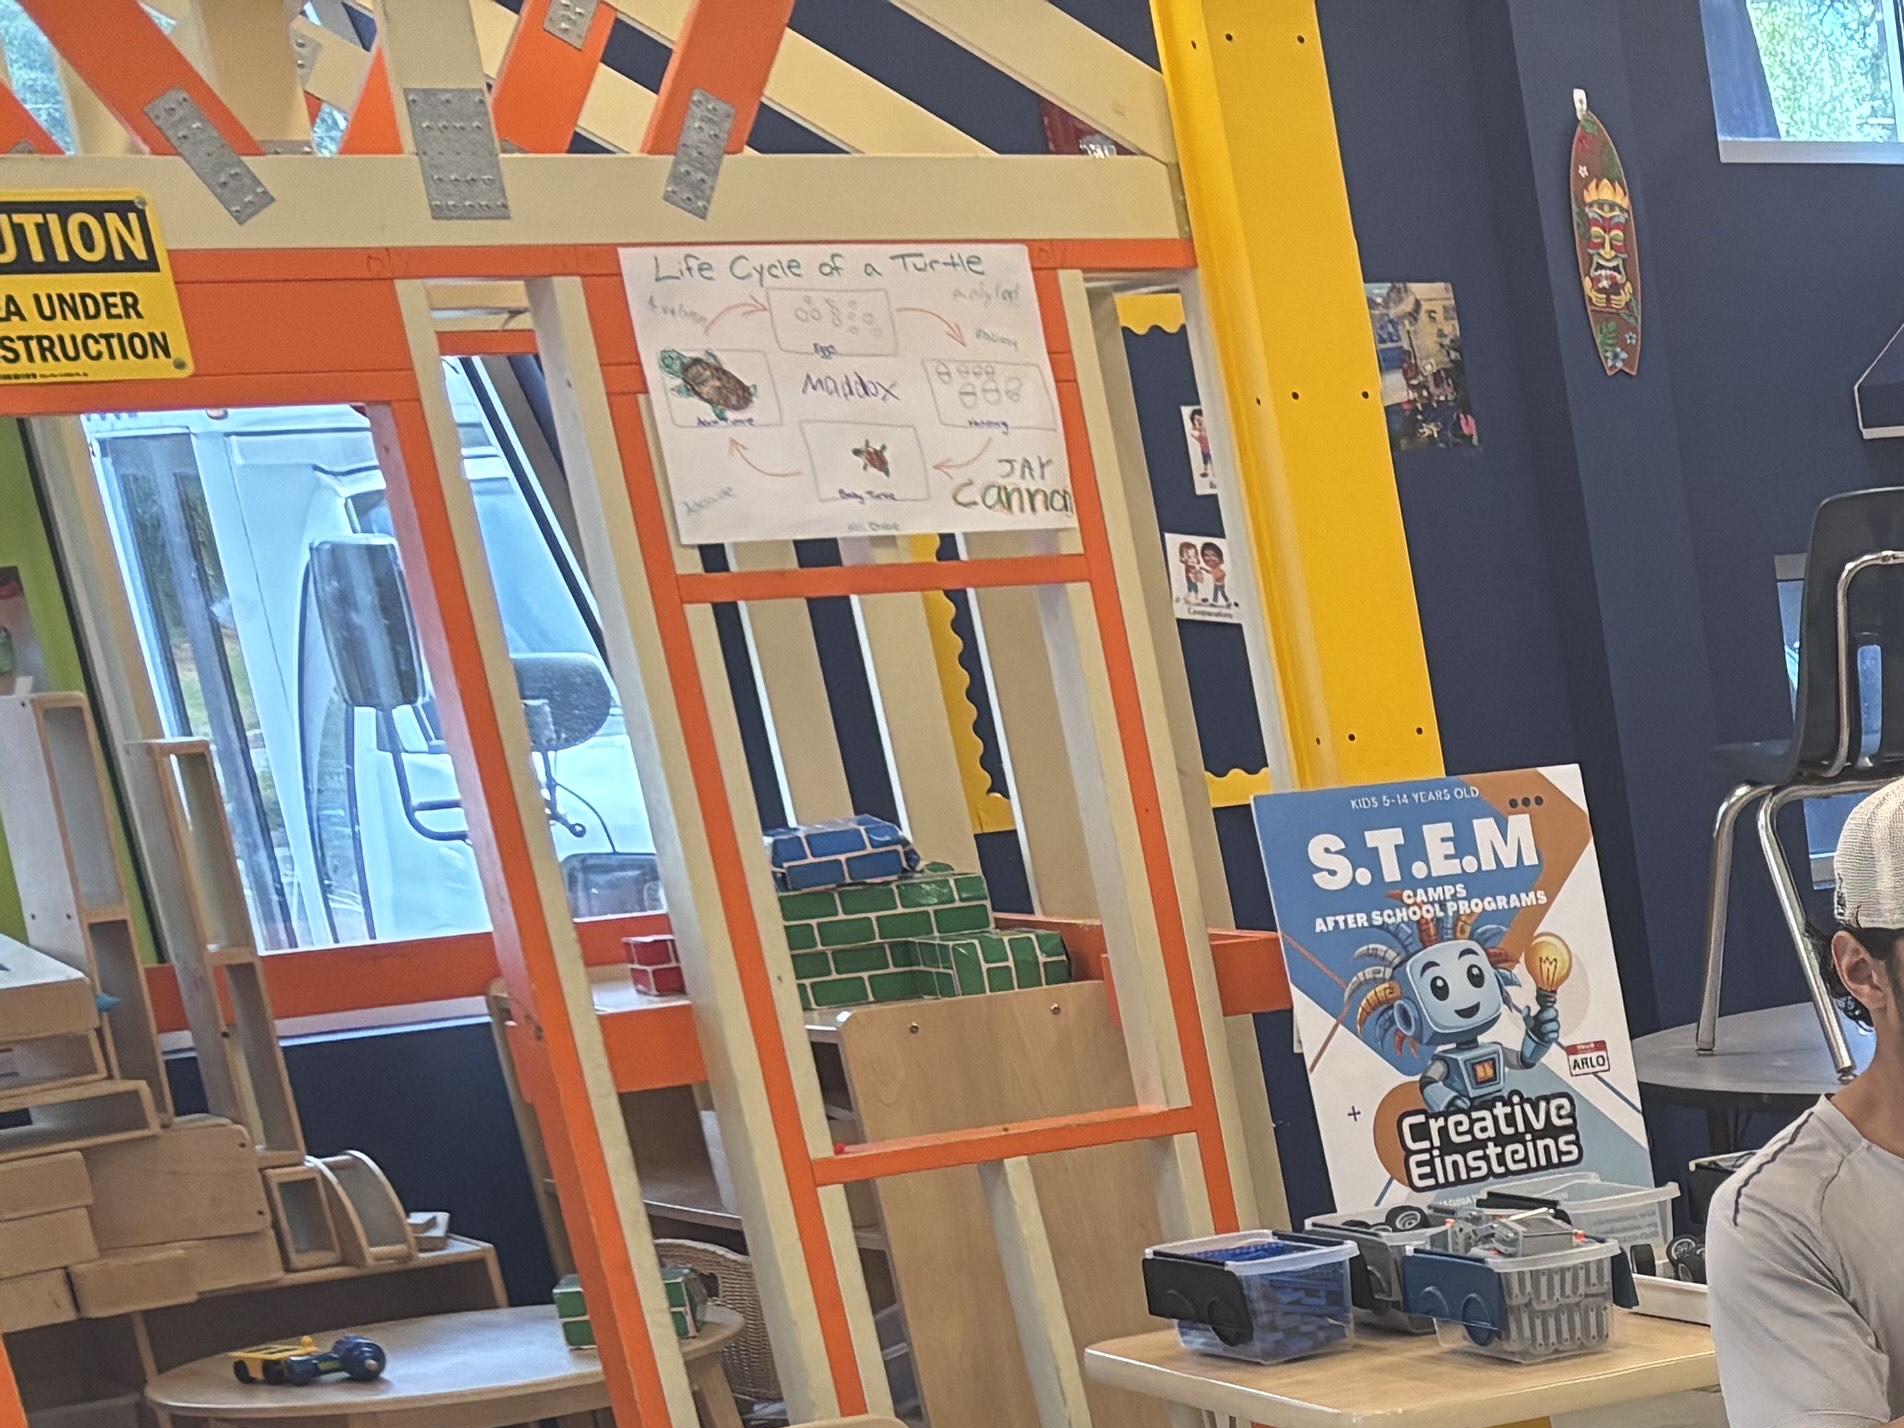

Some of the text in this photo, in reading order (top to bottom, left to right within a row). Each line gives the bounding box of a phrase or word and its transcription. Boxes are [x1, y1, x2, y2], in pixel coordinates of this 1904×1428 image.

[653, 251, 985, 290] Life Cycle of a Turtle
[32, 290, 144, 322] UNDER
[1350, 796, 1378, 811] KIDS
[1411, 789, 1451, 804] YEARS
[1453, 786, 1480, 800] OLD
[1307, 813, 1539, 891] S.T.E.M
[1314, 889, 1548, 934] AFTER SCHOOL PROGRAMS
[1402, 883, 1467, 905] CAMPS
[1402, 1092, 1576, 1151] Creative
[1408, 1131, 1580, 1190] Einsteins
